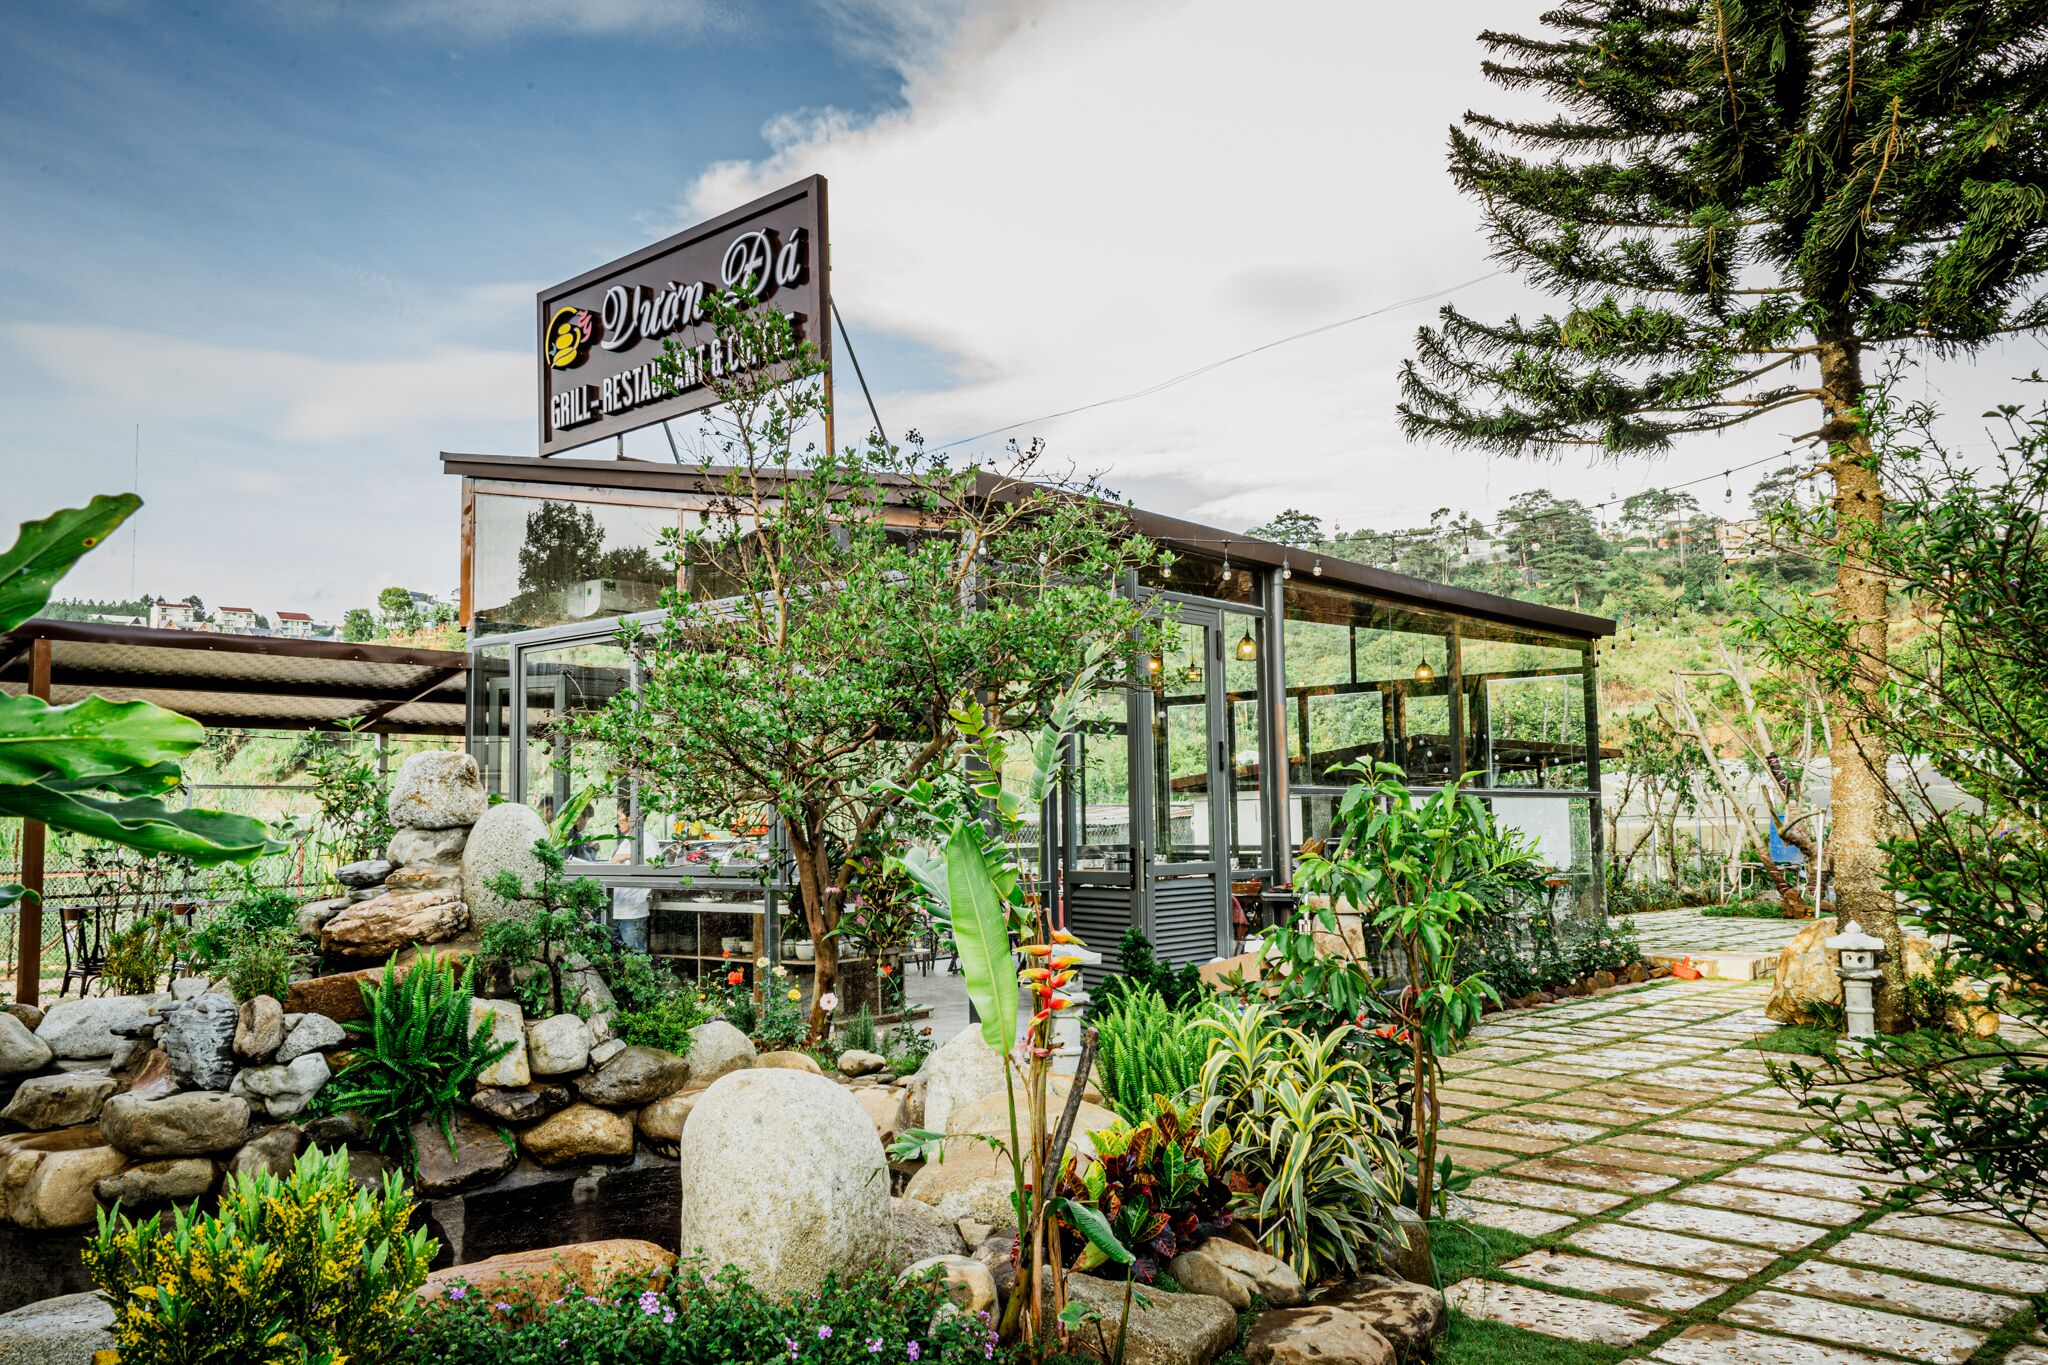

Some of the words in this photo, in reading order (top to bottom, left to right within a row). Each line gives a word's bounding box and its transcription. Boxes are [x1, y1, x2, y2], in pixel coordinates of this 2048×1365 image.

[601, 281, 703, 350] Vườn
[721, 228, 800, 307] Đá
[711, 338, 723, 377] &
